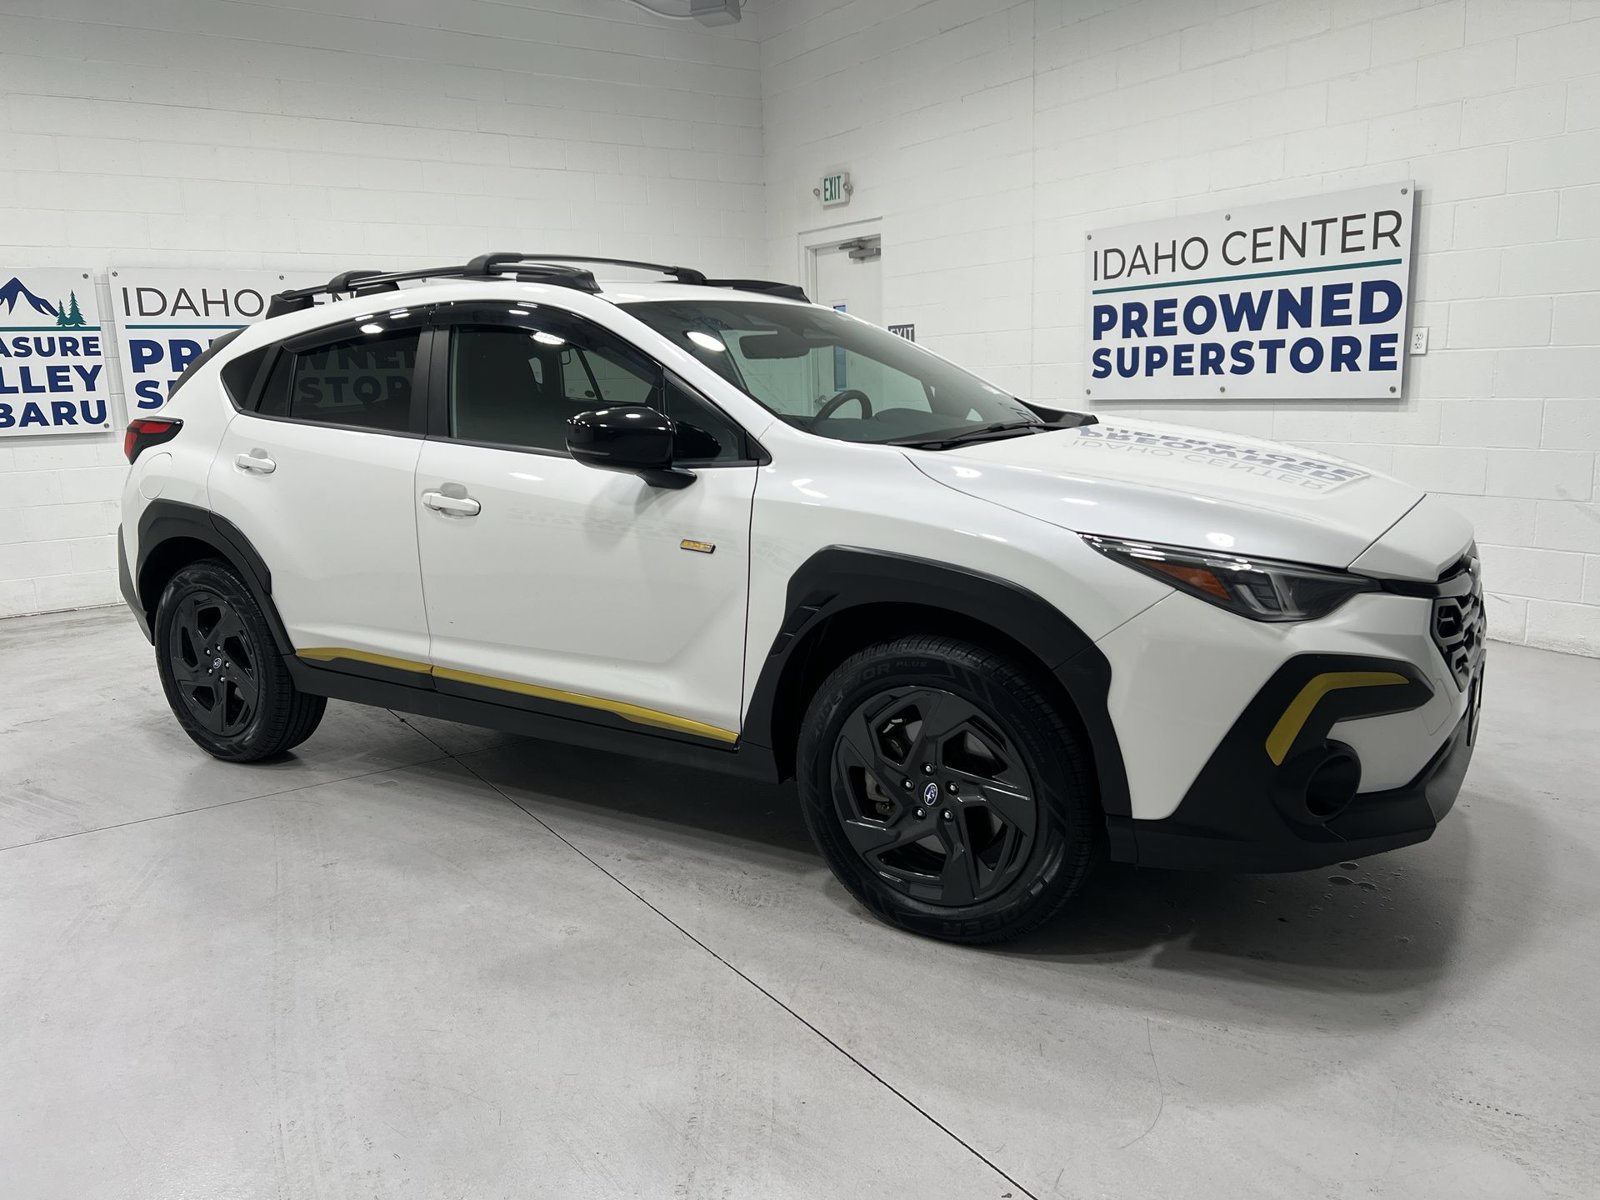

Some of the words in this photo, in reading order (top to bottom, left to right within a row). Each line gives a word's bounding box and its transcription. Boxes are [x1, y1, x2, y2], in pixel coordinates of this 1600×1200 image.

[823, 175, 842, 201] EXIT
[1093, 237, 1209, 281] IDAHO
[1221, 209, 1403, 266] CENTER
[122, 287, 264, 317] IDAHO
[1093, 279, 1403, 340] PREOWNED
[1092, 333, 1399, 379] SUPERSTORE
